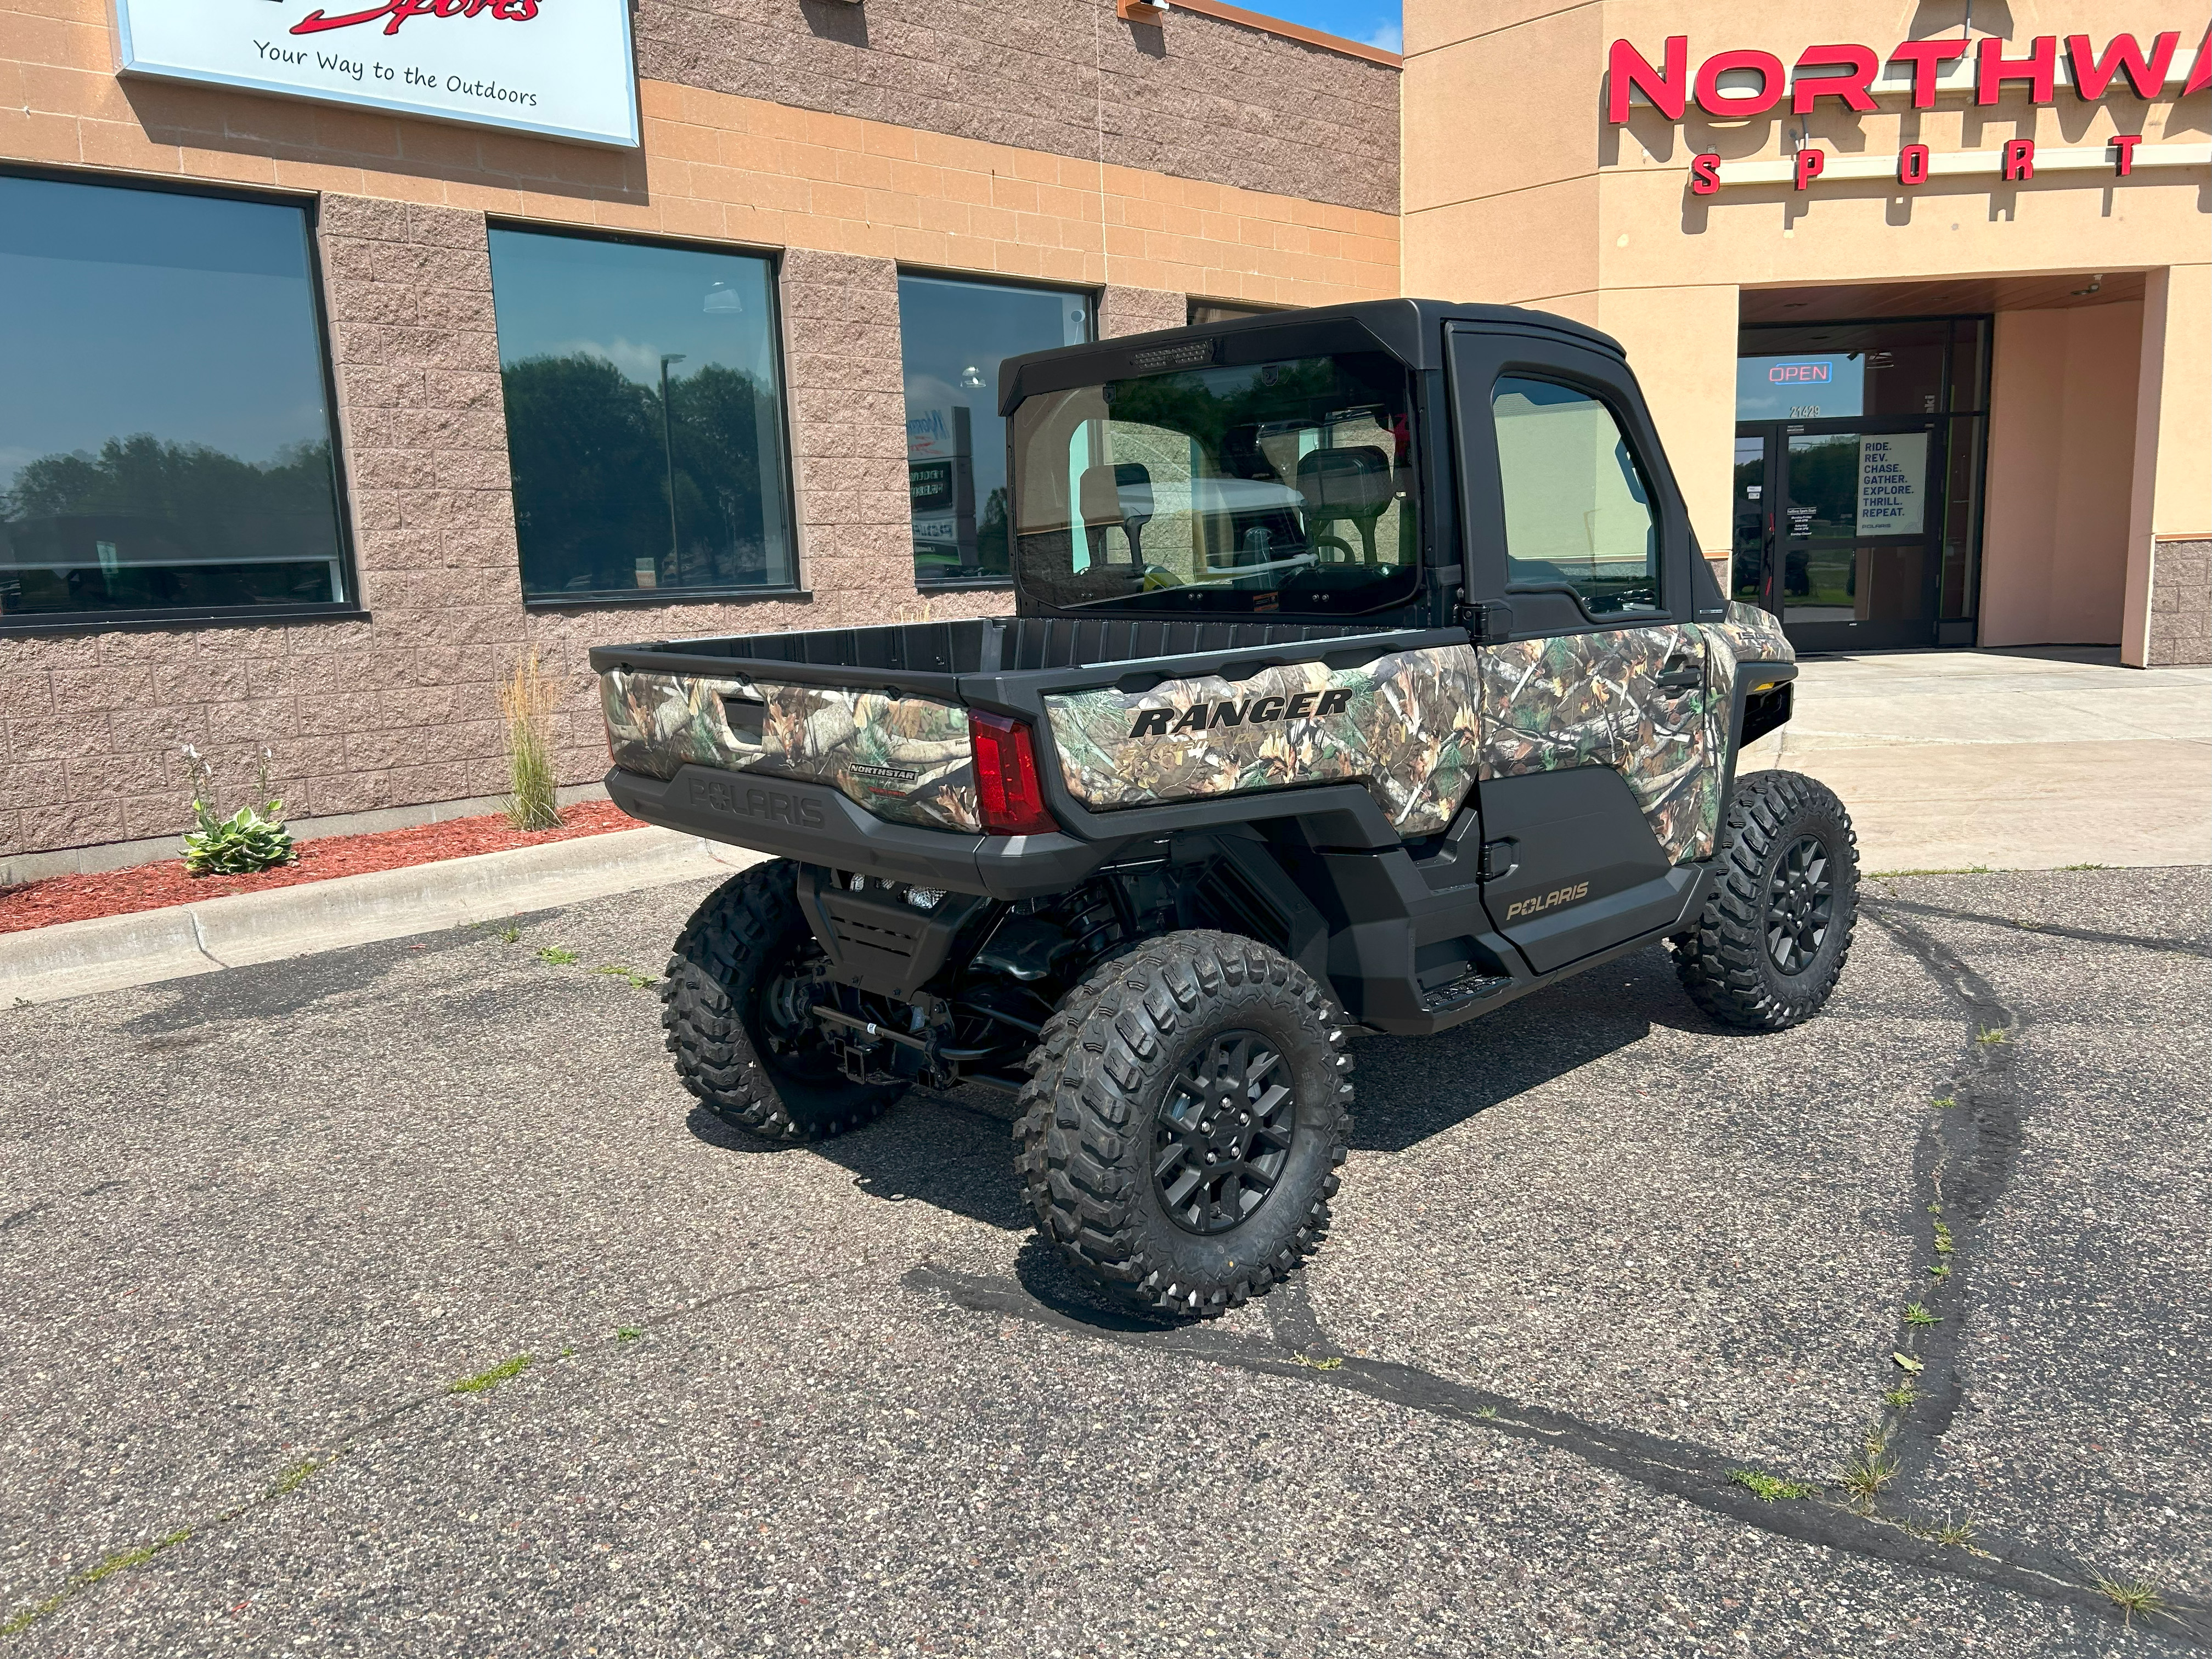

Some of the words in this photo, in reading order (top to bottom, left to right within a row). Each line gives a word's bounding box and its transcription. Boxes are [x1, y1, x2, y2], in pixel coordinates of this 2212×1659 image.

[253, 39, 308, 65] Your
[317, 50, 364, 81] Way
[373, 61, 394, 80] to
[404, 66, 437, 88] the
[447, 75, 537, 106] Outdoors
[1769, 365, 1827, 382] OPEN
[1790, 405, 1820, 418] 21429
[1865, 442, 1892, 452] RIDE.
[1864, 453, 1888, 462] REV.
[1864, 464, 1902, 473] CHASE.
[1864, 475, 1908, 484] GATHER.
[1863, 485, 1914, 496] EXPLORE.
[1863, 497, 1903, 506] THRILL.
[1862, 507, 1905, 518] REPEAT.
[1736, 631, 1777, 640] 1500
[1128, 688, 1353, 739] RANGER
[850, 764, 914, 780] NORTHSTAR
[688, 777, 826, 831] POLARIS
[1505, 881, 1589, 921] POLARIS
